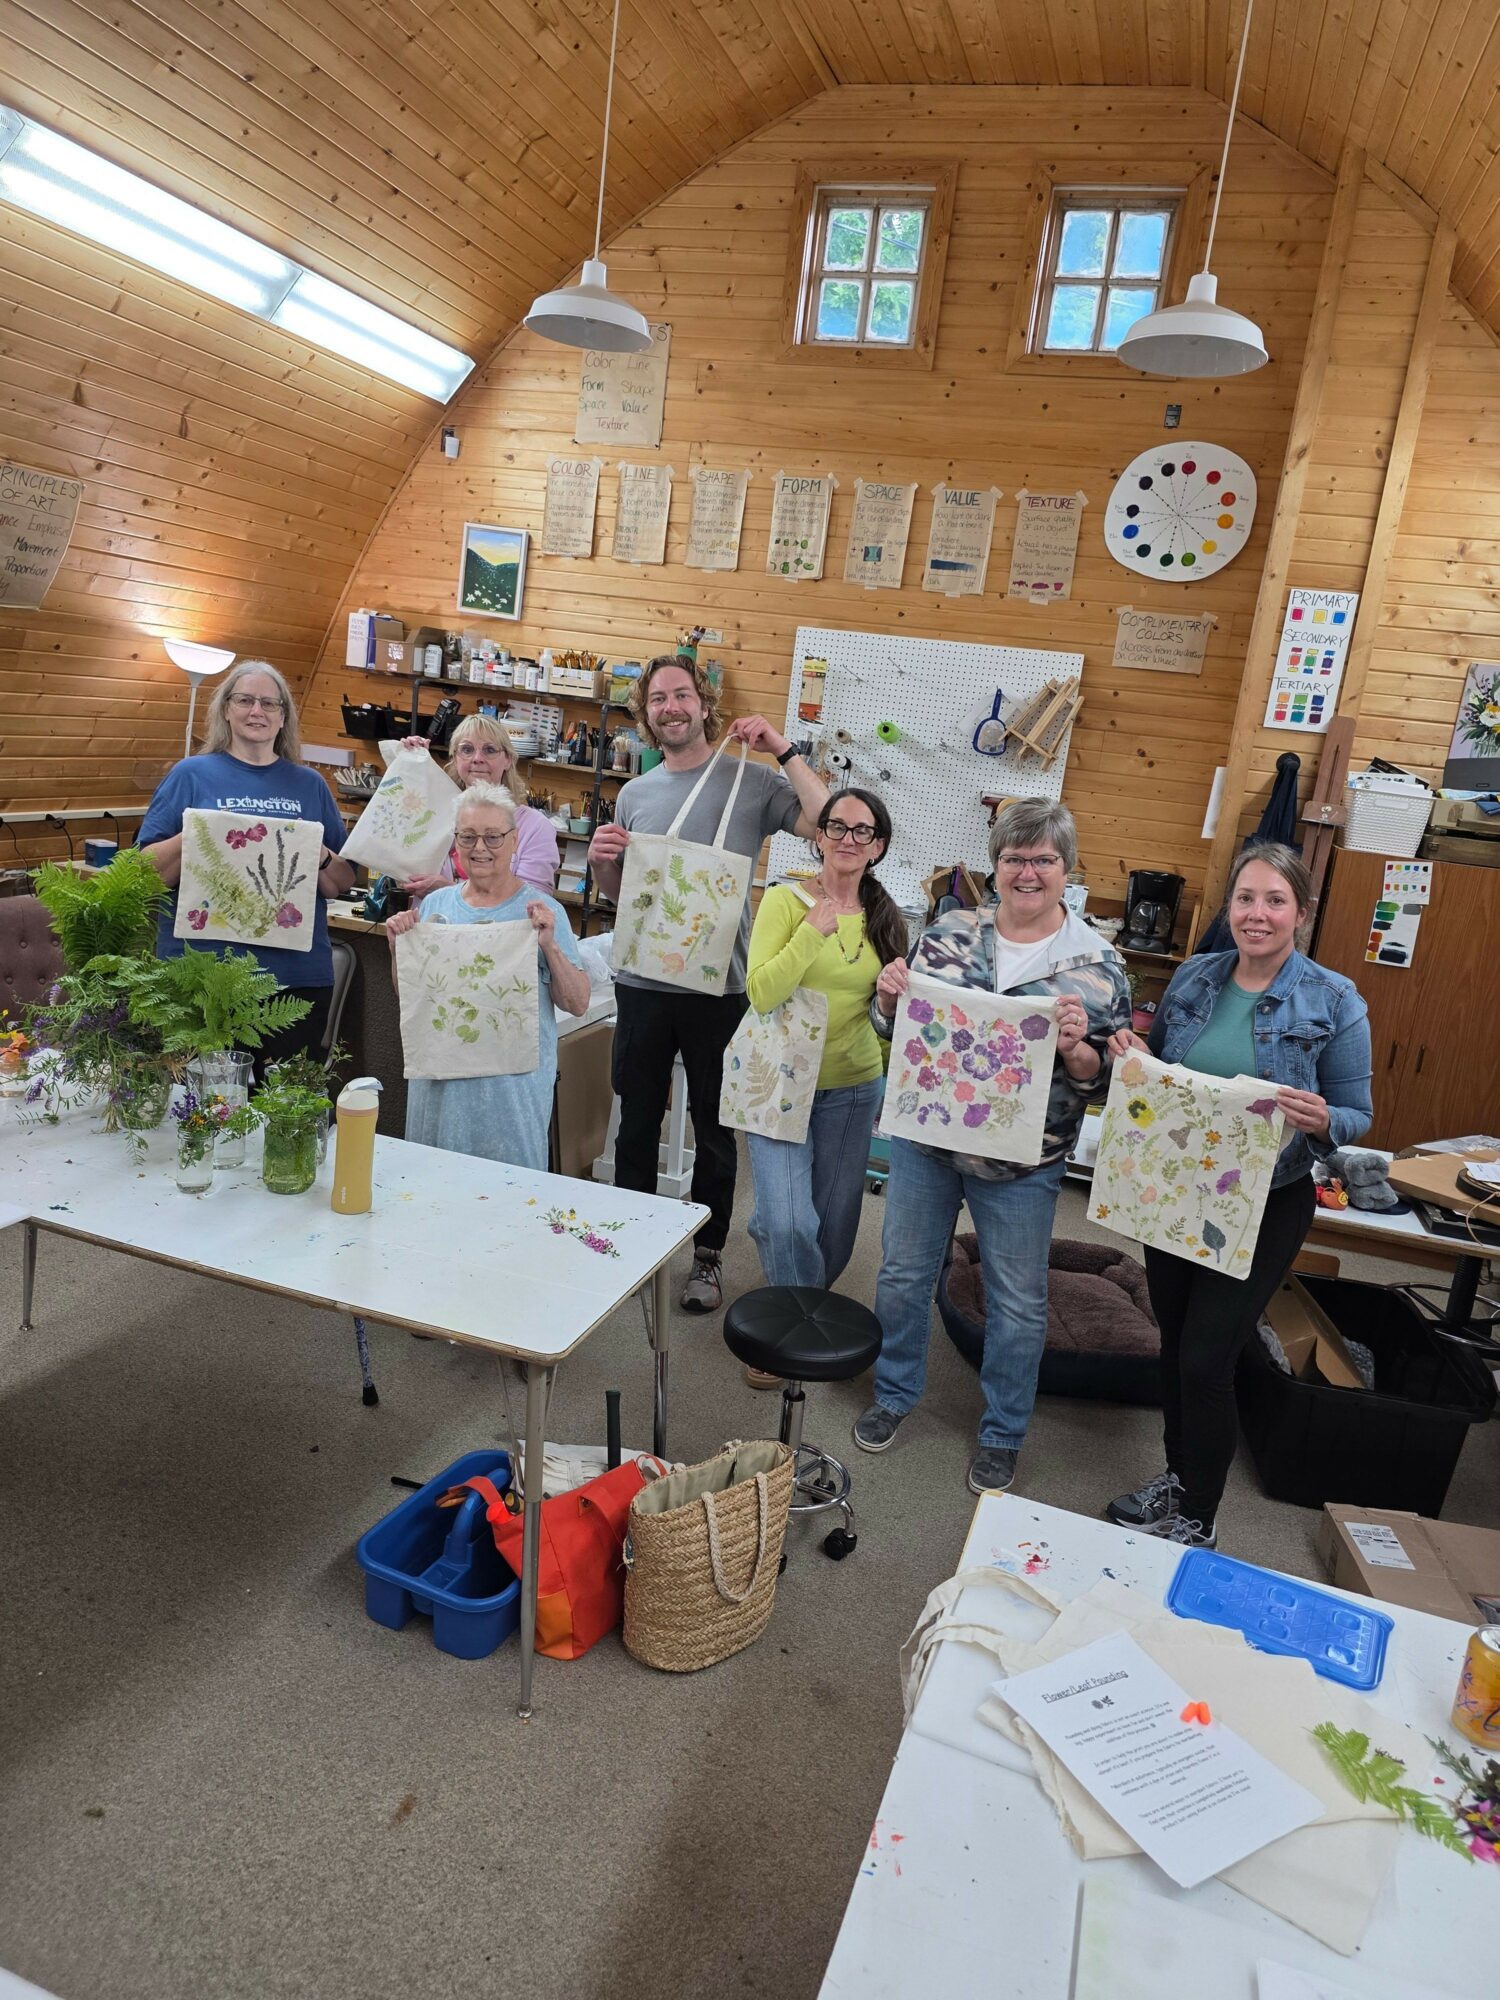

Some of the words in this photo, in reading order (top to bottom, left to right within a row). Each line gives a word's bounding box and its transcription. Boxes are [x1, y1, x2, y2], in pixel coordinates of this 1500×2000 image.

[585, 351, 615, 368] Color
[627, 356, 650, 370] Line
[582, 375, 604, 392] Form
[621, 380, 655, 398] Shape
[579, 397, 606, 412] Space
[622, 401, 648, 414] Value
[595, 416, 630, 430] Texture
[551, 460, 592, 477] COLOR
[624, 468, 656, 480] LINE
[698, 471, 734, 484] SHAPE
[782, 478, 822, 494] FORM
[864, 485, 903, 500] SPACE
[2, 488, 24, 500] OF
[27, 494, 57, 512] ART
[944, 490, 982, 506] VALUE
[1025, 496, 1076, 510] TEXTURE
[28, 514, 70, 538] Emphasis
[14, 536, 60, 558] Movement
[5, 556, 49, 578] Proportion
[1292, 590, 1355, 610] PRIMARY
[1120, 612, 1210, 634] COMPLIMENTARY
[1136, 628, 1184, 644] COLORS
[1283, 628, 1349, 648] SECONDARY
[1274, 676, 1335, 696] TERTIARY
[216, 796, 302, 813] LEXINGTON
[1042, 1680, 1090, 1704] Flower/Leaf
[1090, 1670, 1128, 1686] Pounding
